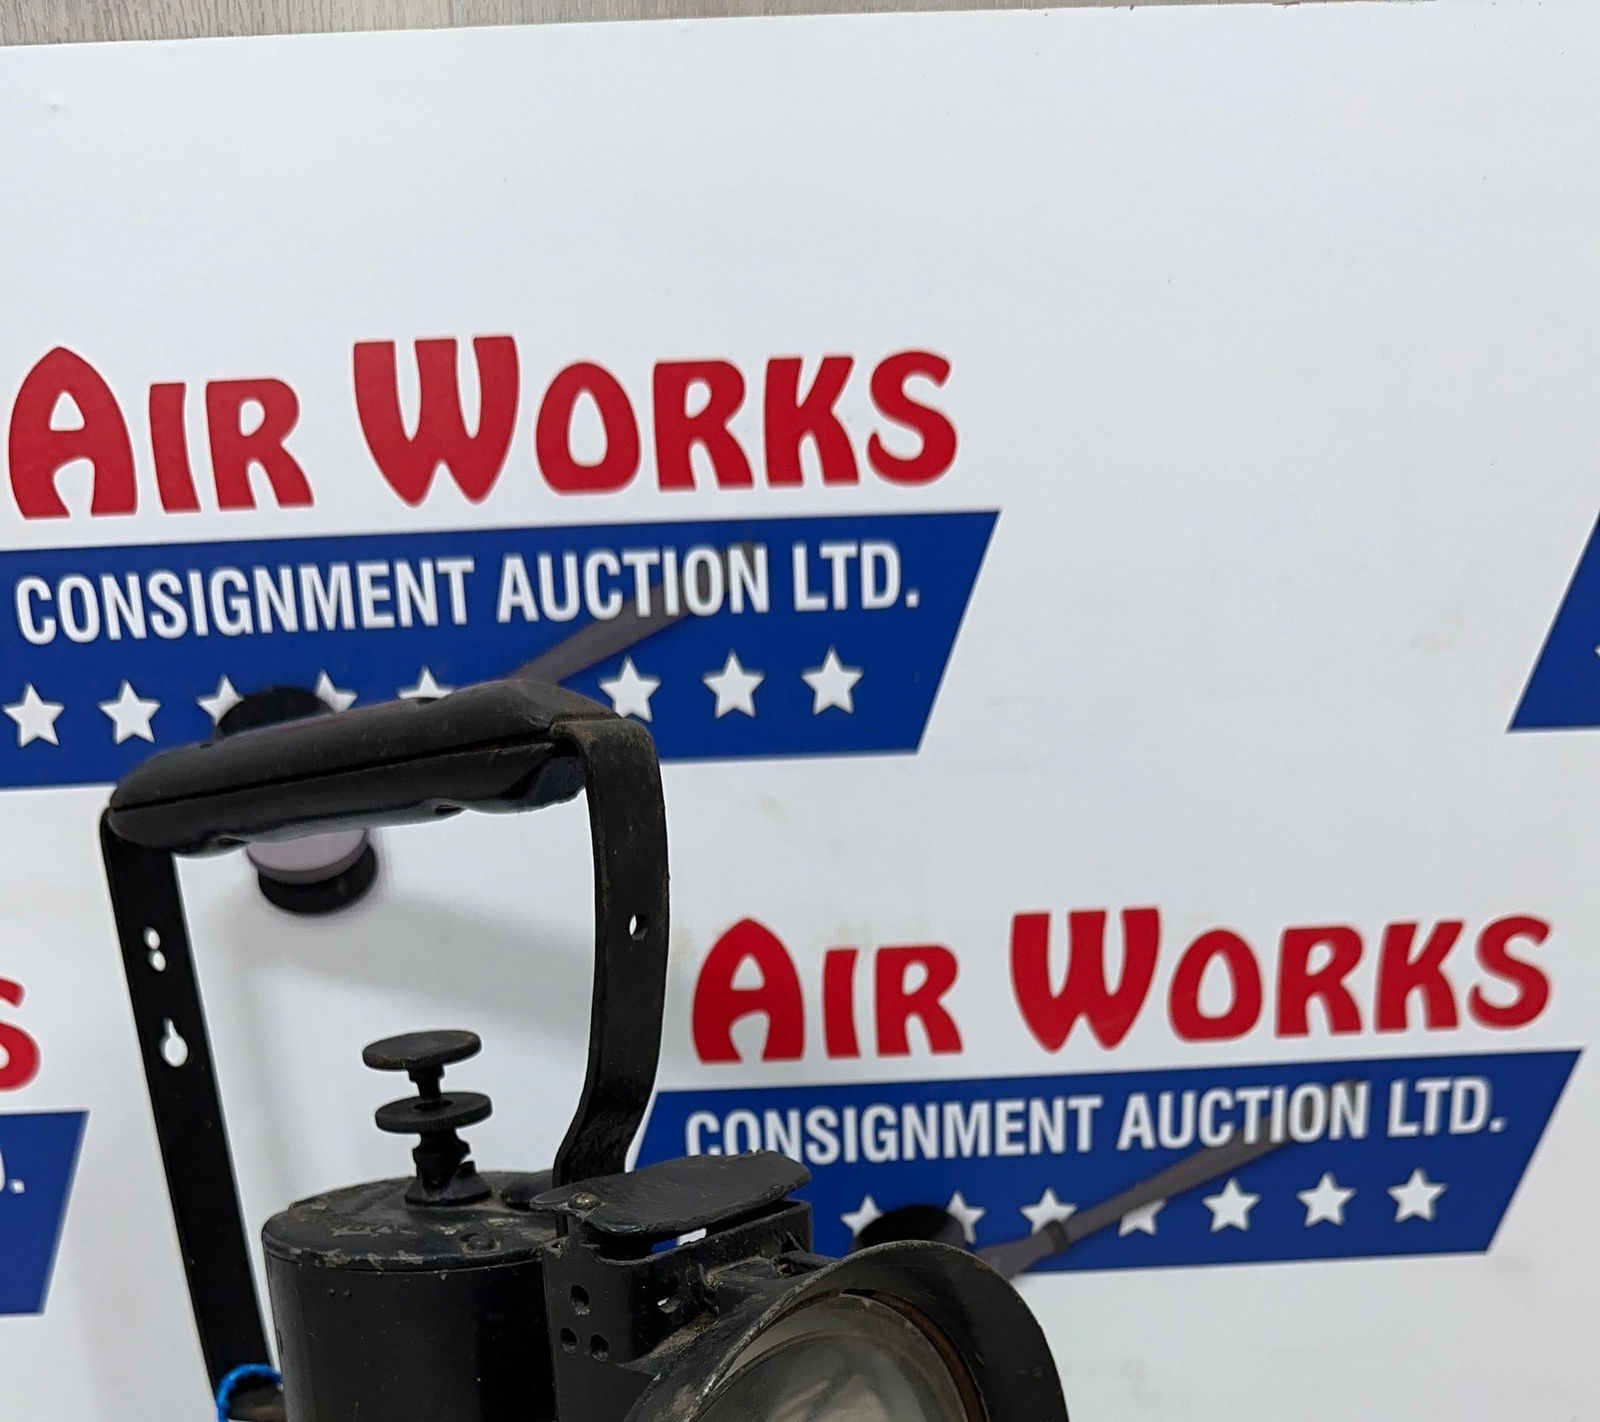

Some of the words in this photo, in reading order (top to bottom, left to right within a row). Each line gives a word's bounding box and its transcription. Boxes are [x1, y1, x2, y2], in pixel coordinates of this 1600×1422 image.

[9, 345, 315, 520] AIR
[353, 334, 958, 508] WORKS
[17, 557, 476, 646] CONSIGNMENT
[497, 543, 771, 625] AUCTION
[792, 541, 921, 613] LTD.
[691, 916, 964, 1065] AIR
[1009, 907, 1552, 1054] WORKS
[684, 1094, 1103, 1166] CONSIGNMENT
[1117, 1081, 1370, 1153] AUCTION
[1387, 1075, 1508, 1138] LTD.
